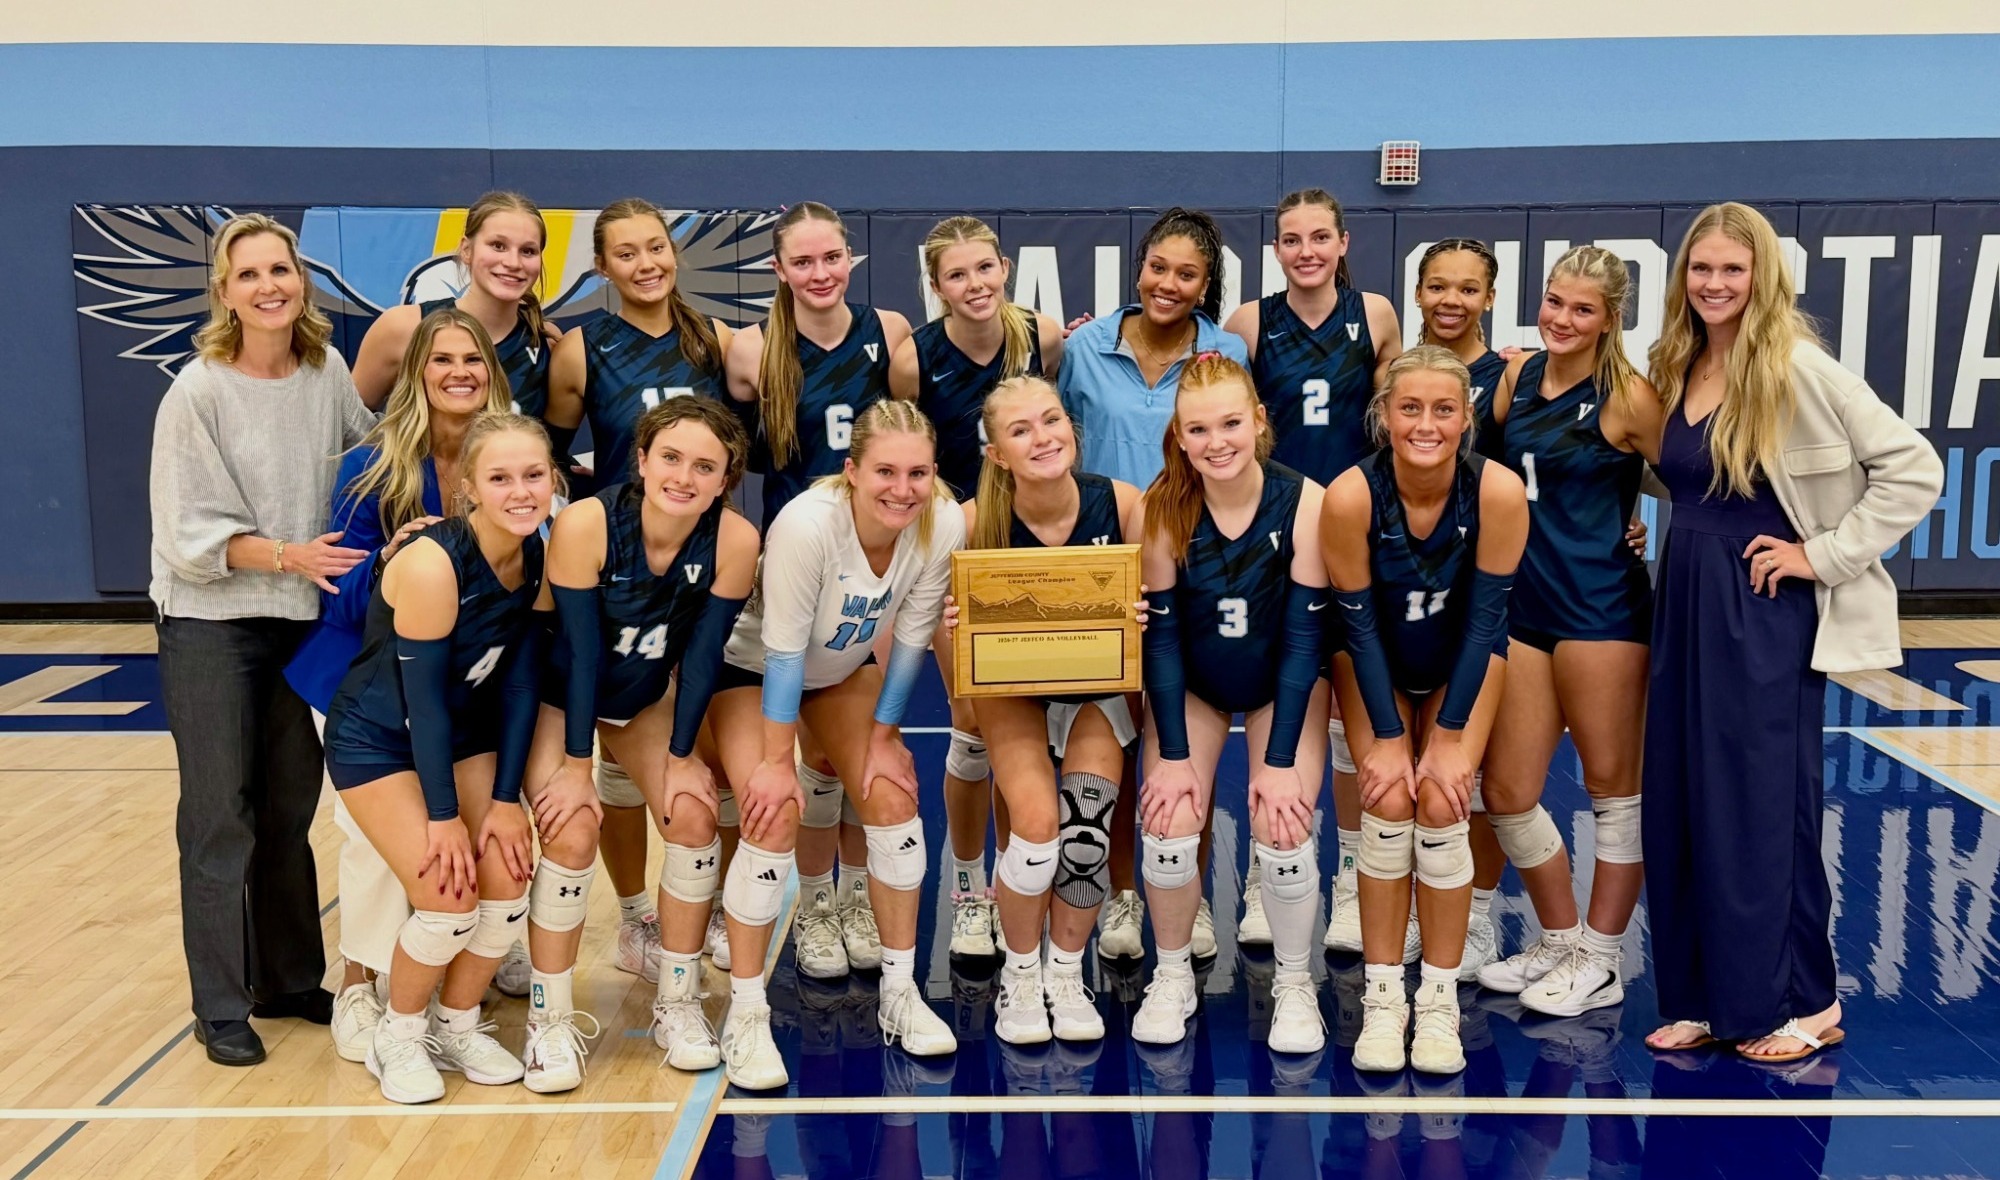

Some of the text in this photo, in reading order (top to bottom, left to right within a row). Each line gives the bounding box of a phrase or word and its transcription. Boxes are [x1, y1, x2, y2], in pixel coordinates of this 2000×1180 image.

[1345, 323, 1360, 341] V
[525, 346, 539, 364] V
[864, 343, 879, 362] V
[1302, 379, 1331, 426] 2
[1577, 403, 1595, 421] V
[825, 404, 854, 450] 6
[1521, 452, 1539, 502] 1
[684, 564, 702, 584] V
[1217, 597, 1248, 638] 3
[614, 624, 668, 660] 14
[466, 646, 505, 687] 4
